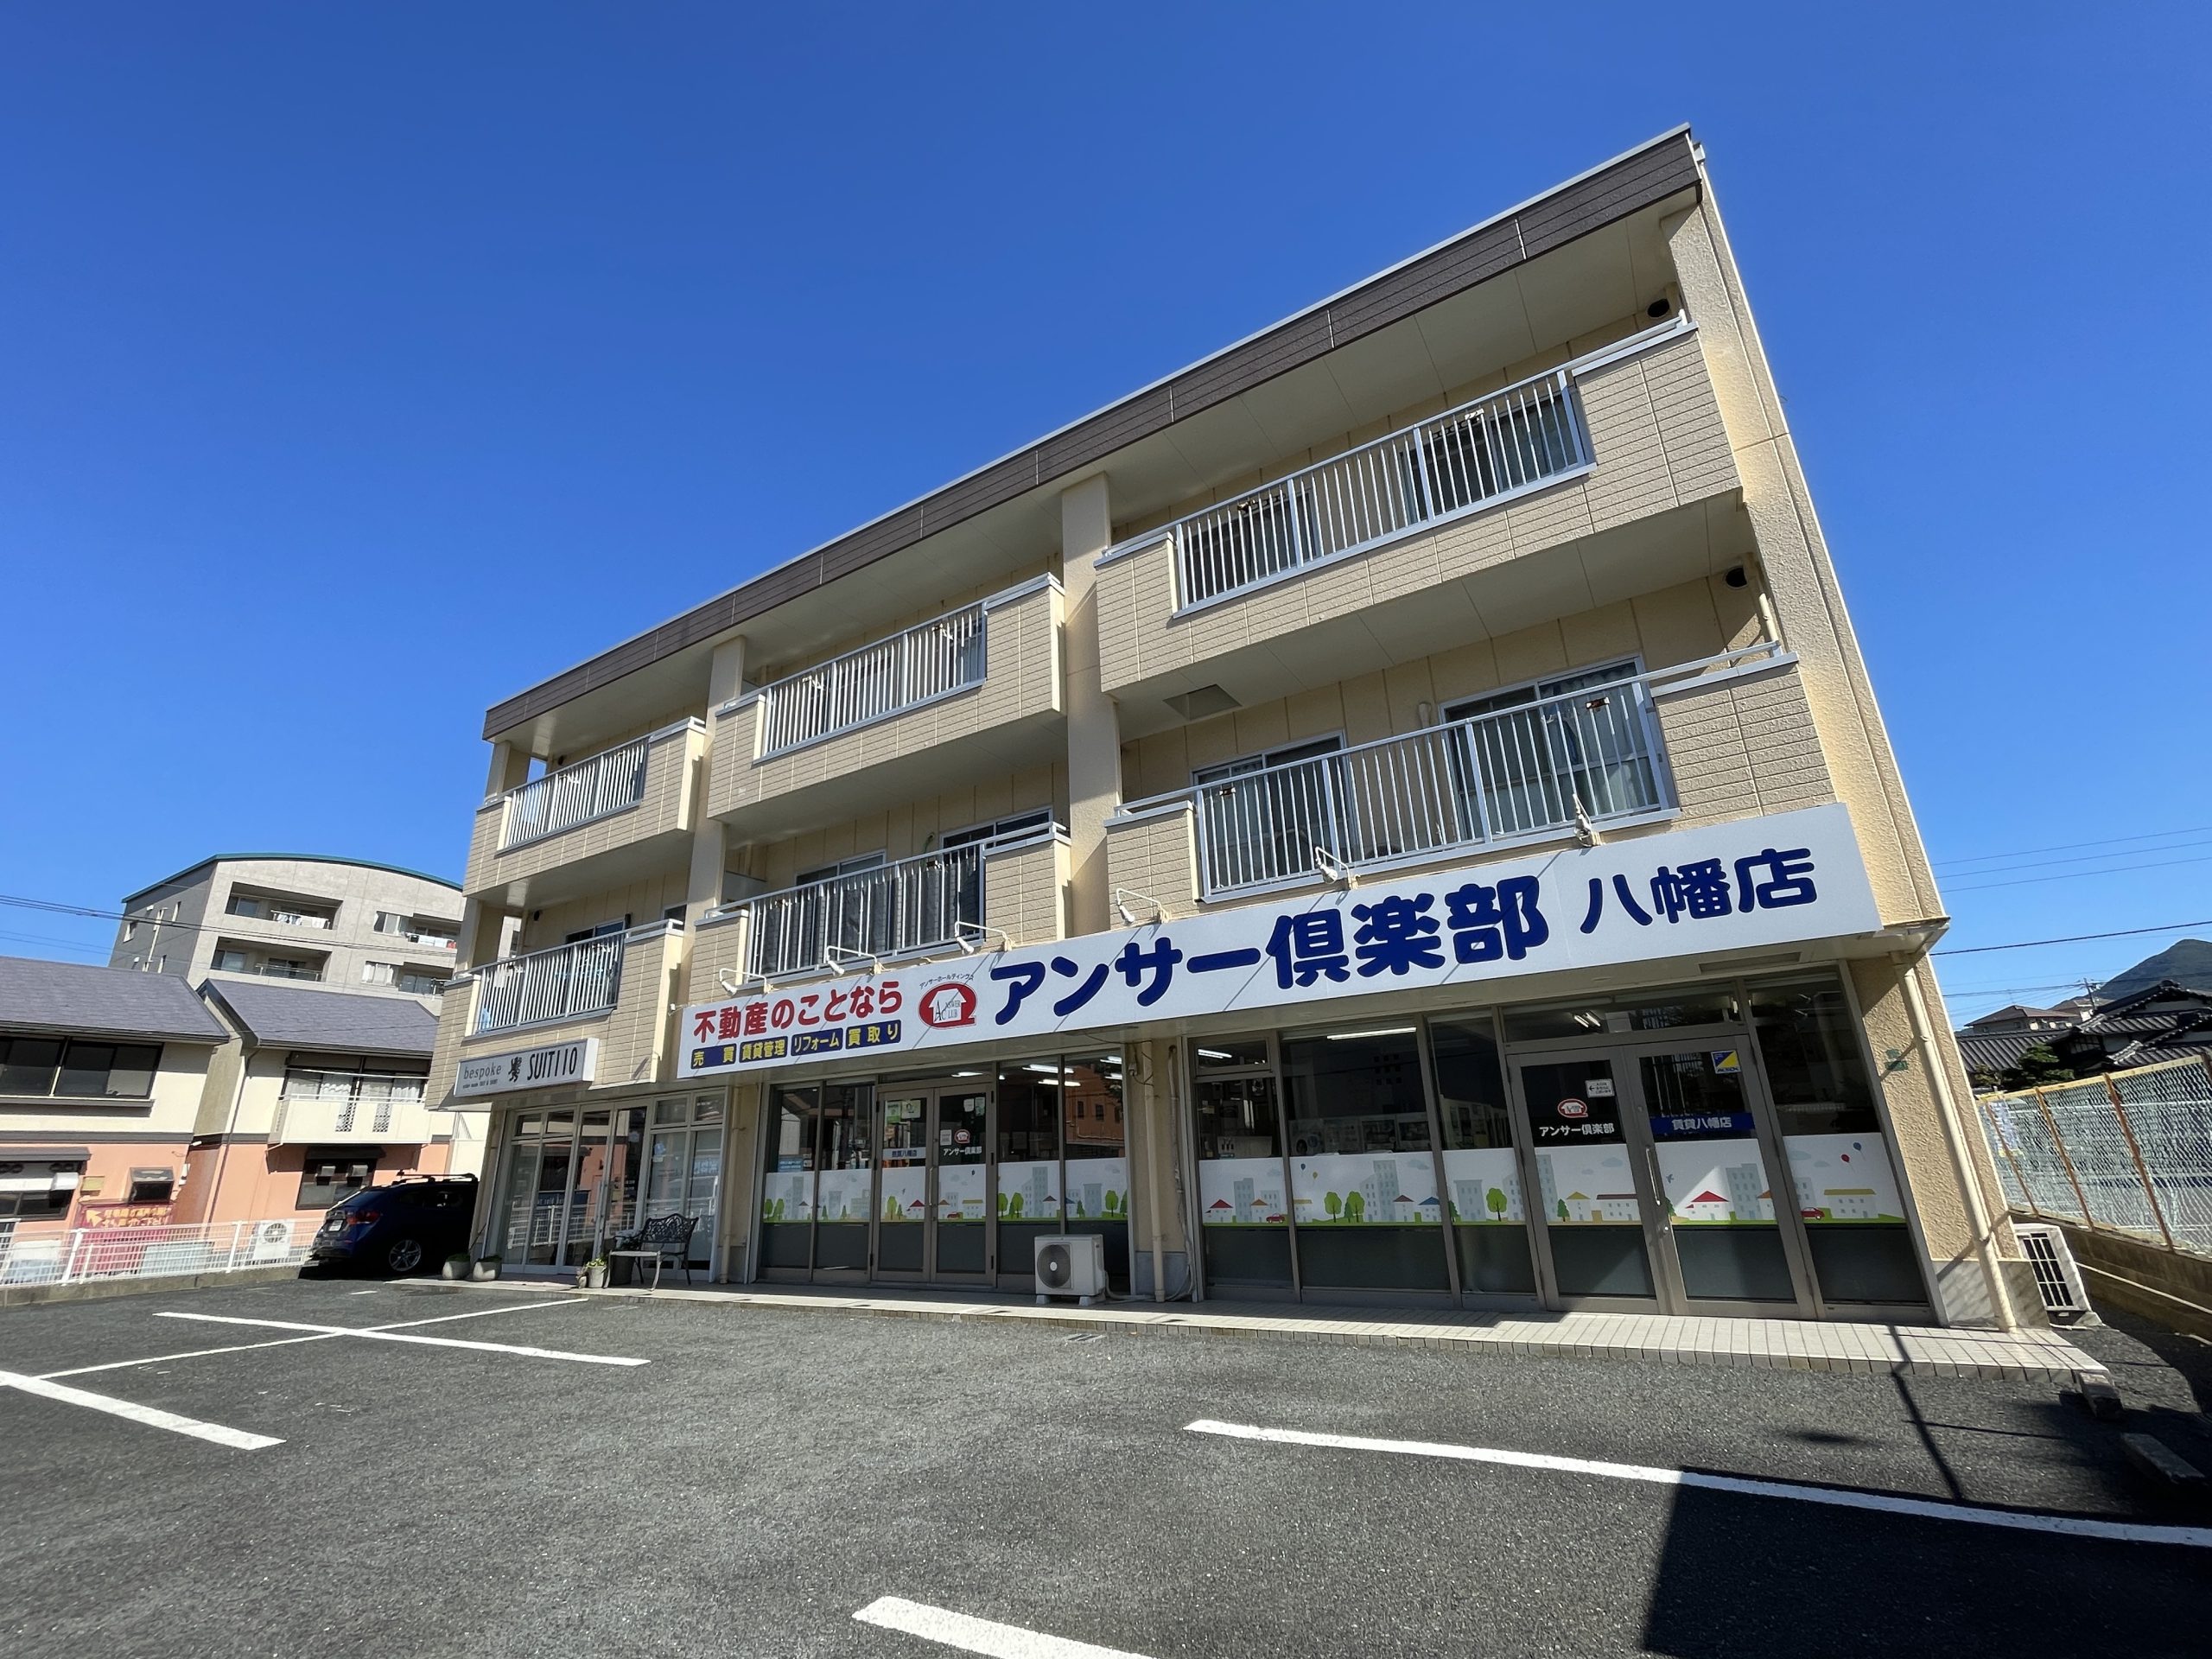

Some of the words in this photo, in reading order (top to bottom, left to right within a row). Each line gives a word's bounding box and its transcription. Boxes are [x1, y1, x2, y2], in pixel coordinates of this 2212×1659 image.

[990, 875, 1549, 1026] アンサー倶楽部
[1581, 848, 1815, 934] 八幡店
[694, 981, 902, 1043] 不動産のことなら
[741, 1039, 786, 1061] 賃貸管理
[794, 1032, 840, 1053] リフォーム
[848, 1024, 899, 1046] 買取り
[464, 1062, 502, 1080] bespoke
[1539, 1122, 1615, 1137] アンサー倶楽部
